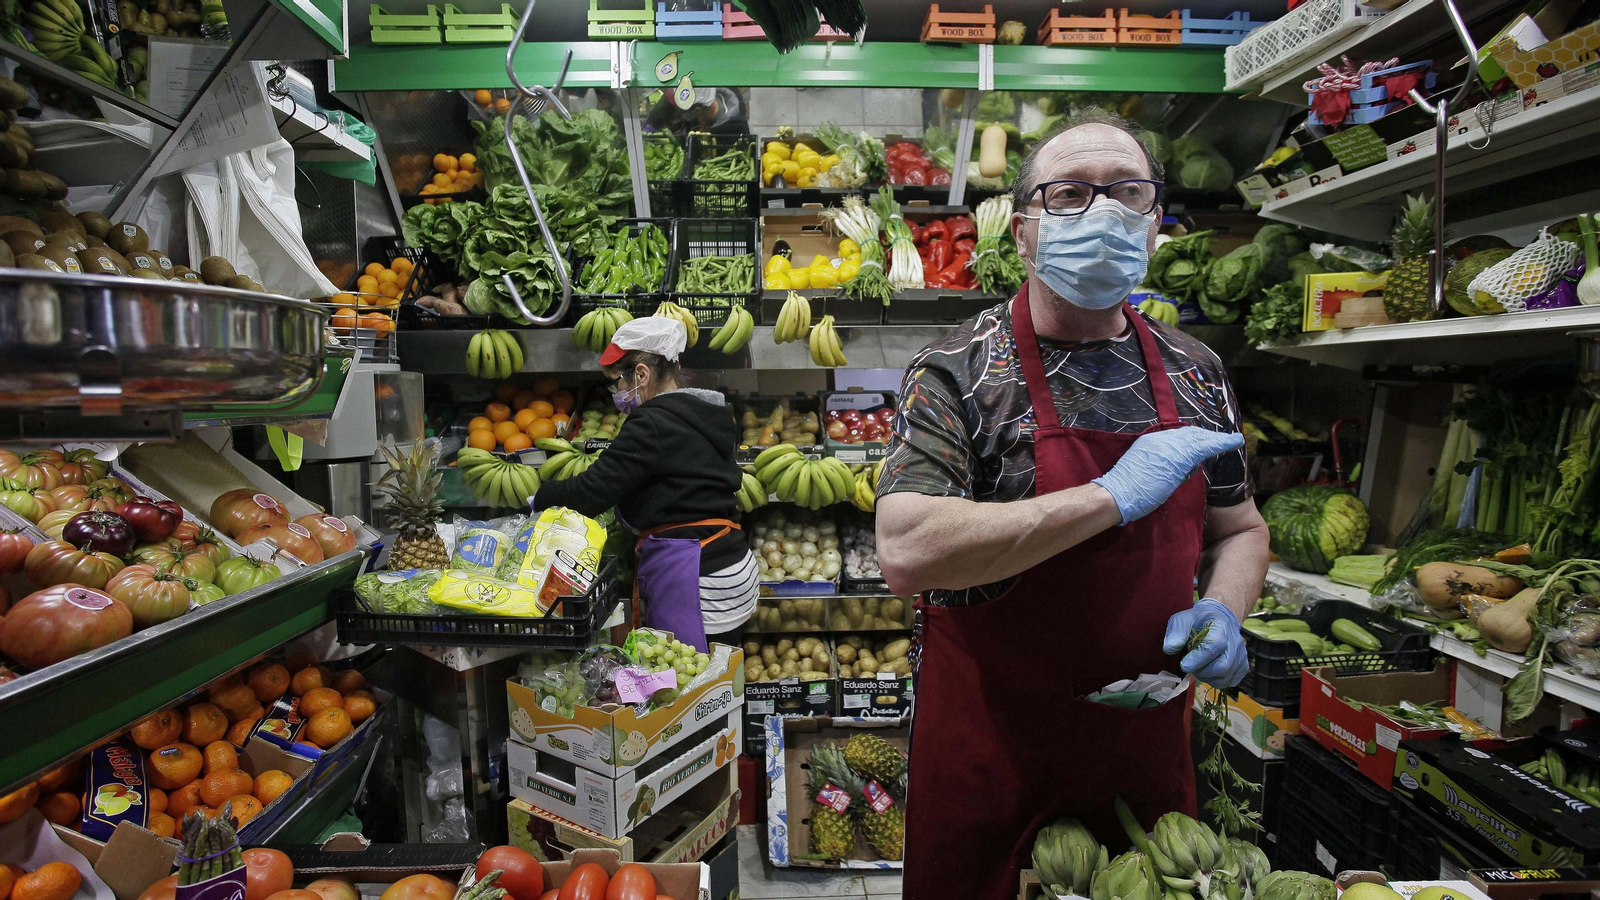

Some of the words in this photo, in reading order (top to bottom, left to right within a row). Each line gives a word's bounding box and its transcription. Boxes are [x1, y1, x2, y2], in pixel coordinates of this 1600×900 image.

[599, 25, 622, 35] WOOD
[626, 25, 644, 35] BOX
[941, 28, 964, 37] WOOD
[968, 28, 985, 37] BOX
[1061, 32, 1084, 41] WOOD
[1088, 32, 1105, 42] BOX
[1129, 33, 1152, 42] WOOD
[1155, 33, 1172, 43] BOX
[843, 680, 875, 690] Eduardo
[875, 680, 900, 689] Sanz
[745, 686, 780, 696] Eduardo
[780, 685, 803, 695] Sanz
